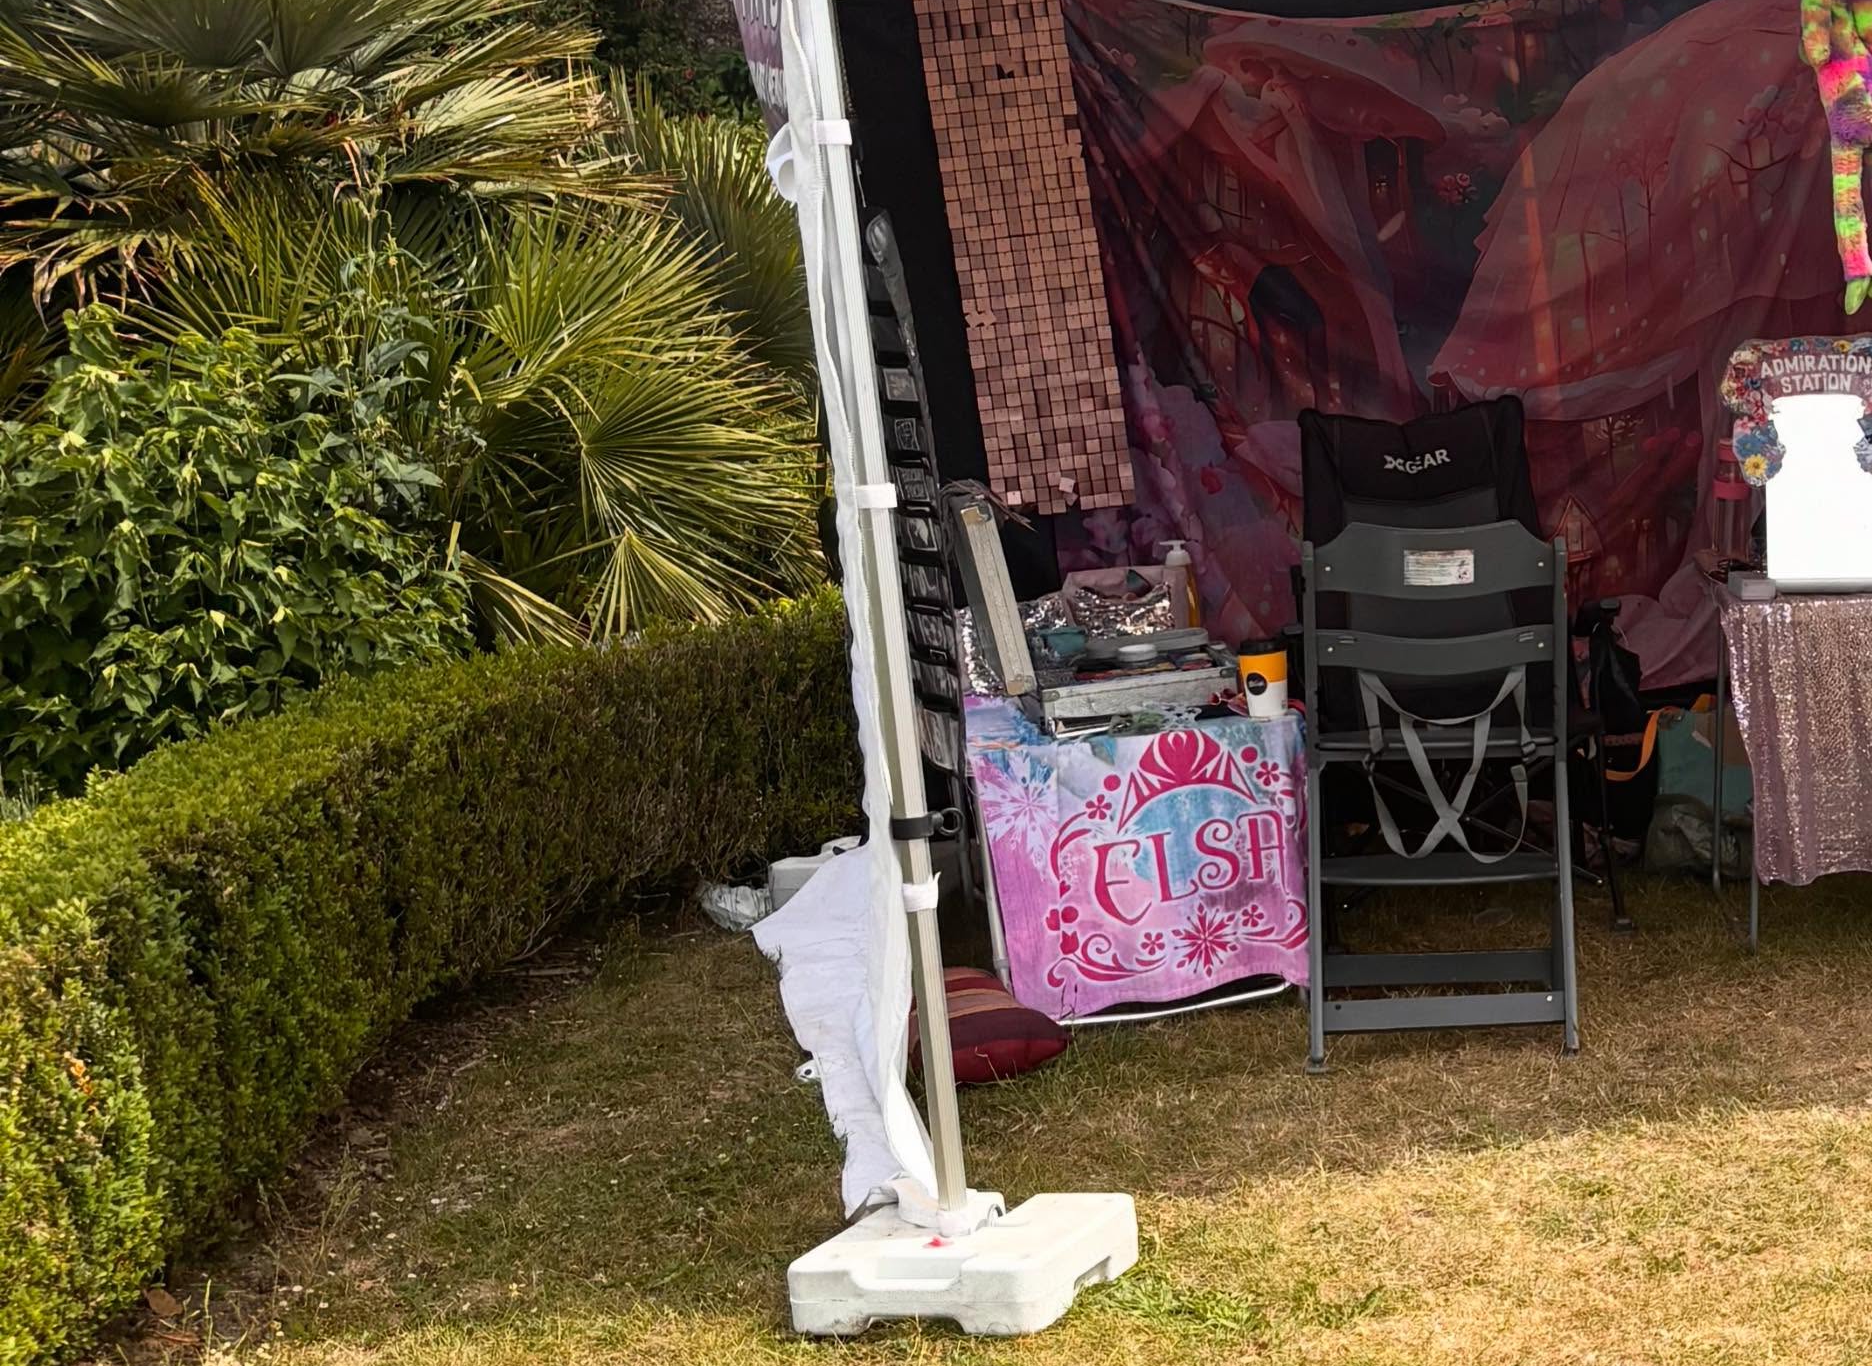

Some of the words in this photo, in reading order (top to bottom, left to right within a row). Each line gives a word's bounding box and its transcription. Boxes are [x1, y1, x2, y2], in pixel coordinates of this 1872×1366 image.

[1760, 353, 1872, 379] ADMiRATiON
[1780, 372, 1852, 394] STATiON
[1091, 810, 1290, 927] ELSA
